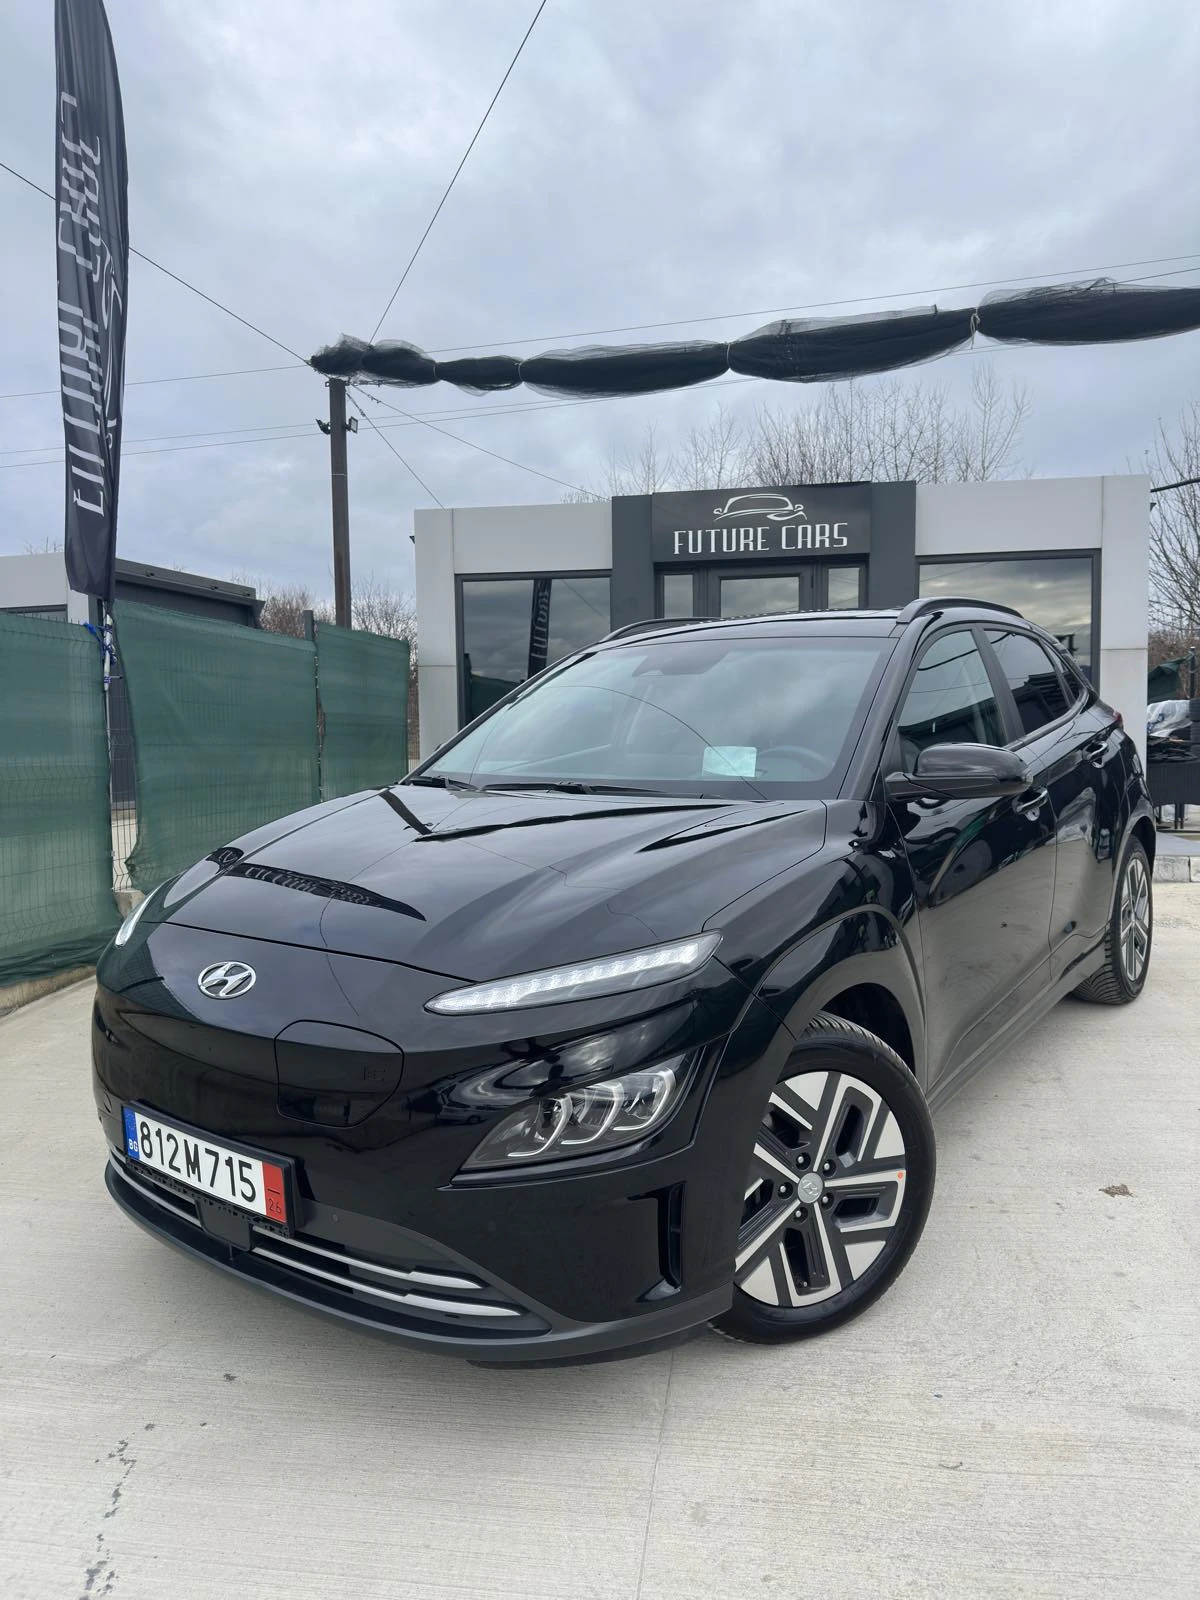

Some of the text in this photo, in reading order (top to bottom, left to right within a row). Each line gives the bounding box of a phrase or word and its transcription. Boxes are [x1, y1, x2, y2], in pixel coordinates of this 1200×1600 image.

[673, 522, 848, 555] FUTURE CARS
[128, 1138, 139, 1152] BG
[139, 1120, 257, 1203] 812M715
[268, 1198, 282, 1215] 26
